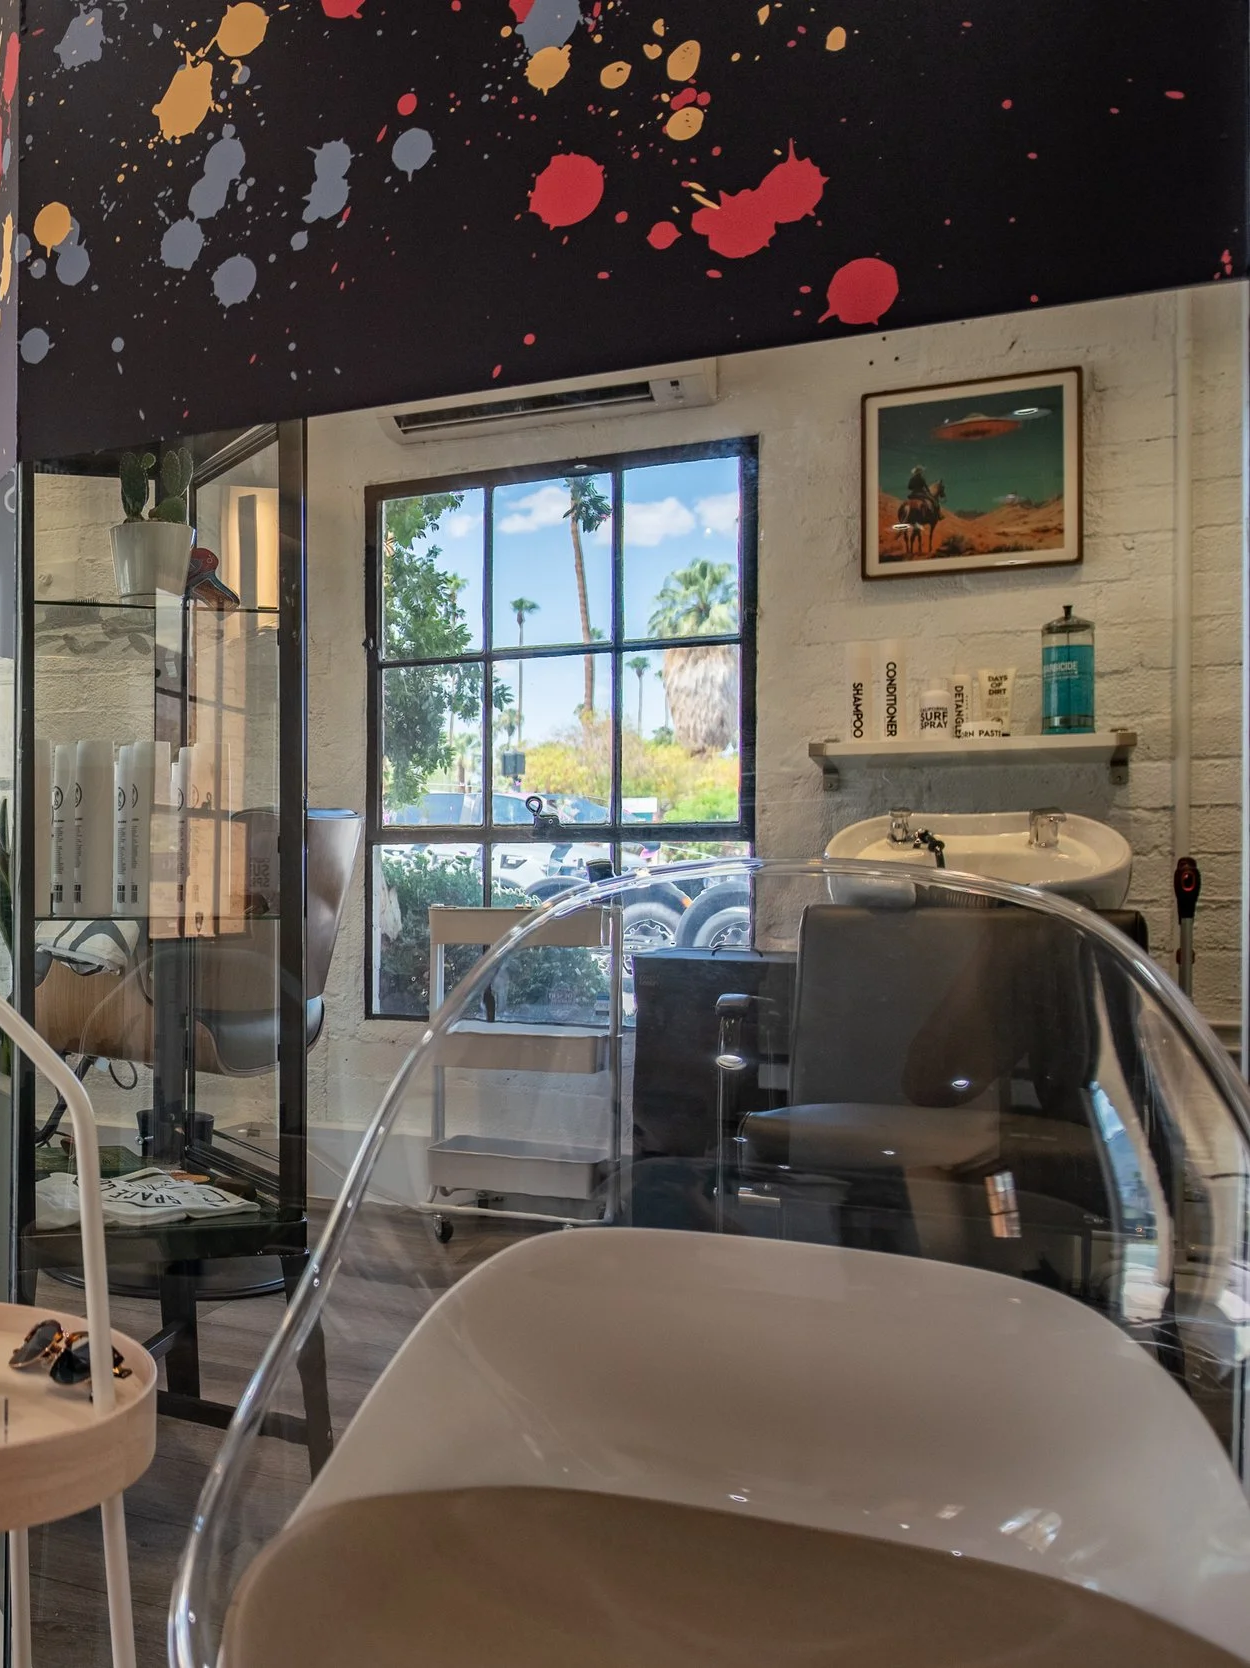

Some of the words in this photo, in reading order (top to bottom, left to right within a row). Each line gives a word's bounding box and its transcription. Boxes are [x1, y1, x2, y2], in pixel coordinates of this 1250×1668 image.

[852, 682, 864, 738] SHAMPOO
[886, 661, 897, 737] CONDITIONER
[920, 711, 948, 721] SURF
[920, 721, 948, 730] SPRAY
